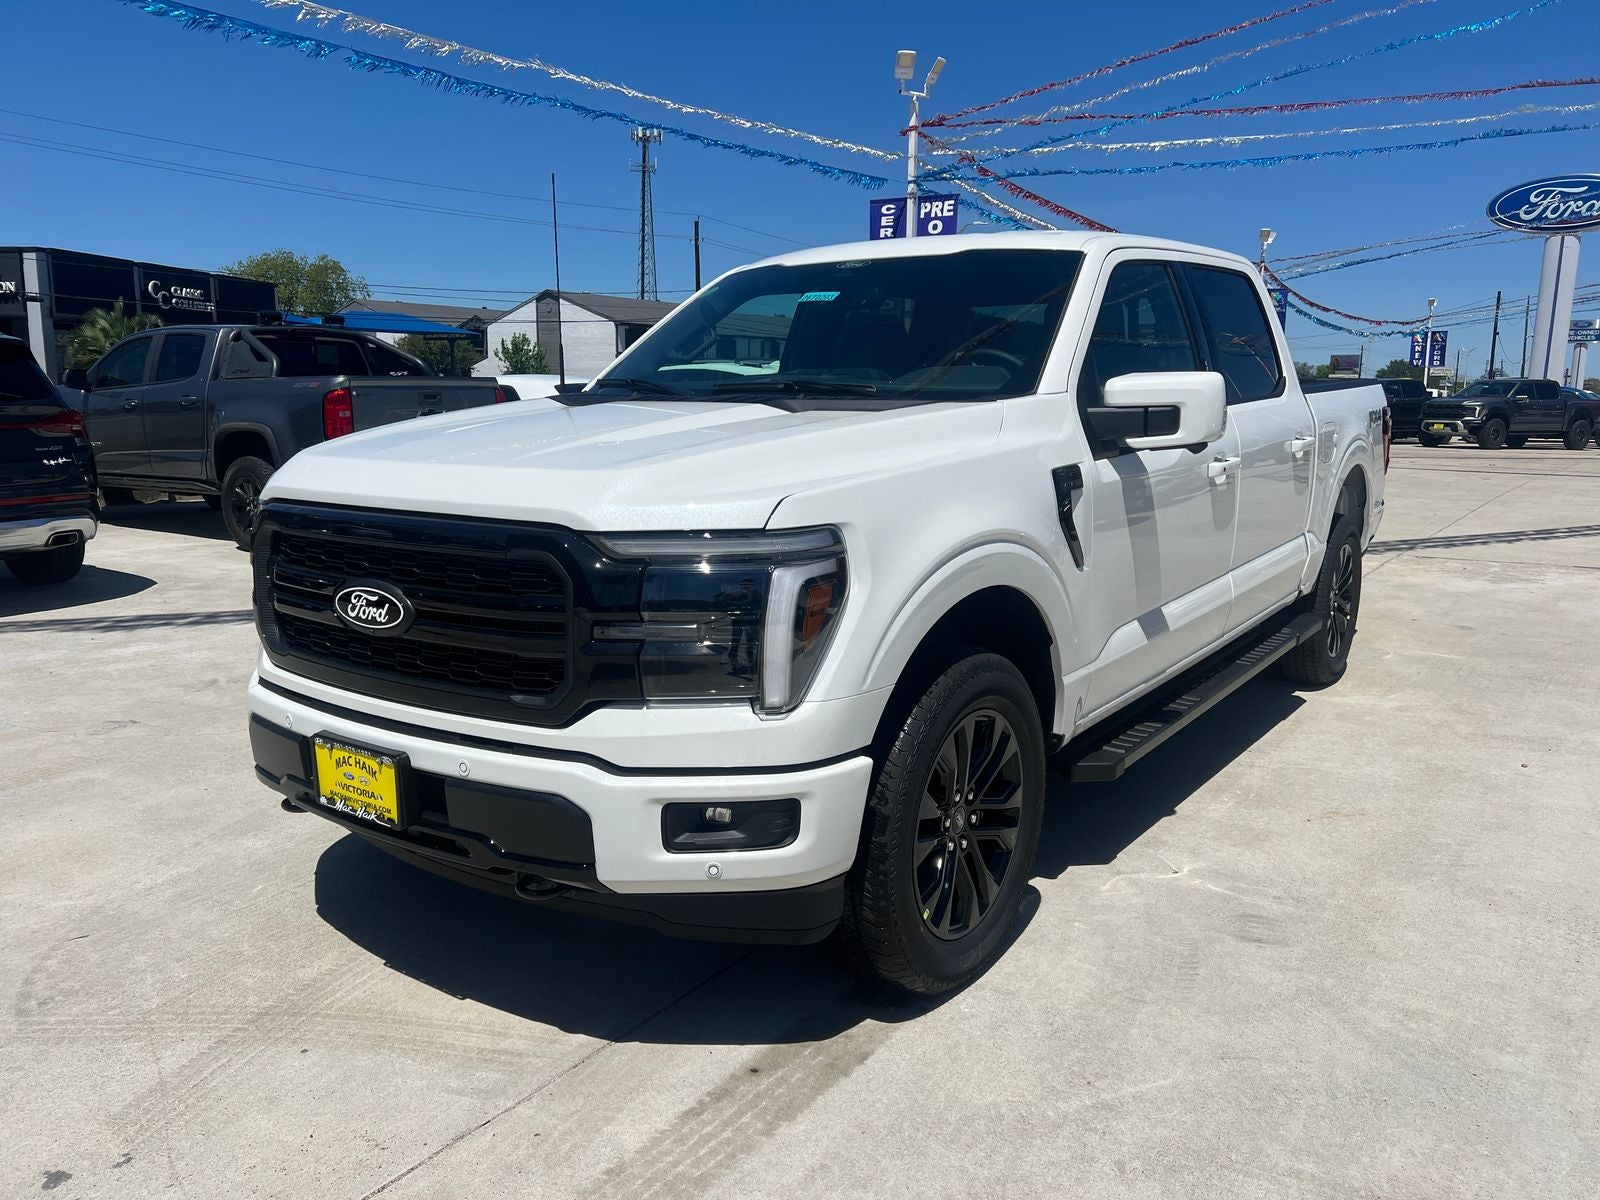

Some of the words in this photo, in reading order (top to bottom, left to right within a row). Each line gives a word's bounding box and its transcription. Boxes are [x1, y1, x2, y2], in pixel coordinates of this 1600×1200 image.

[920, 200, 955, 218] PRE
[927, 220, 943, 235] O
[171, 286, 204, 300] CLASSIC
[1413, 345, 1422, 366] NEW
[1433, 344, 1441, 366] FORD
[347, 591, 389, 623] Ford
[335, 755, 353, 771] MAC
[354, 756, 378, 782] HAIK
[341, 782, 376, 801] VICTORIA
[333, 799, 355, 815] Mac
